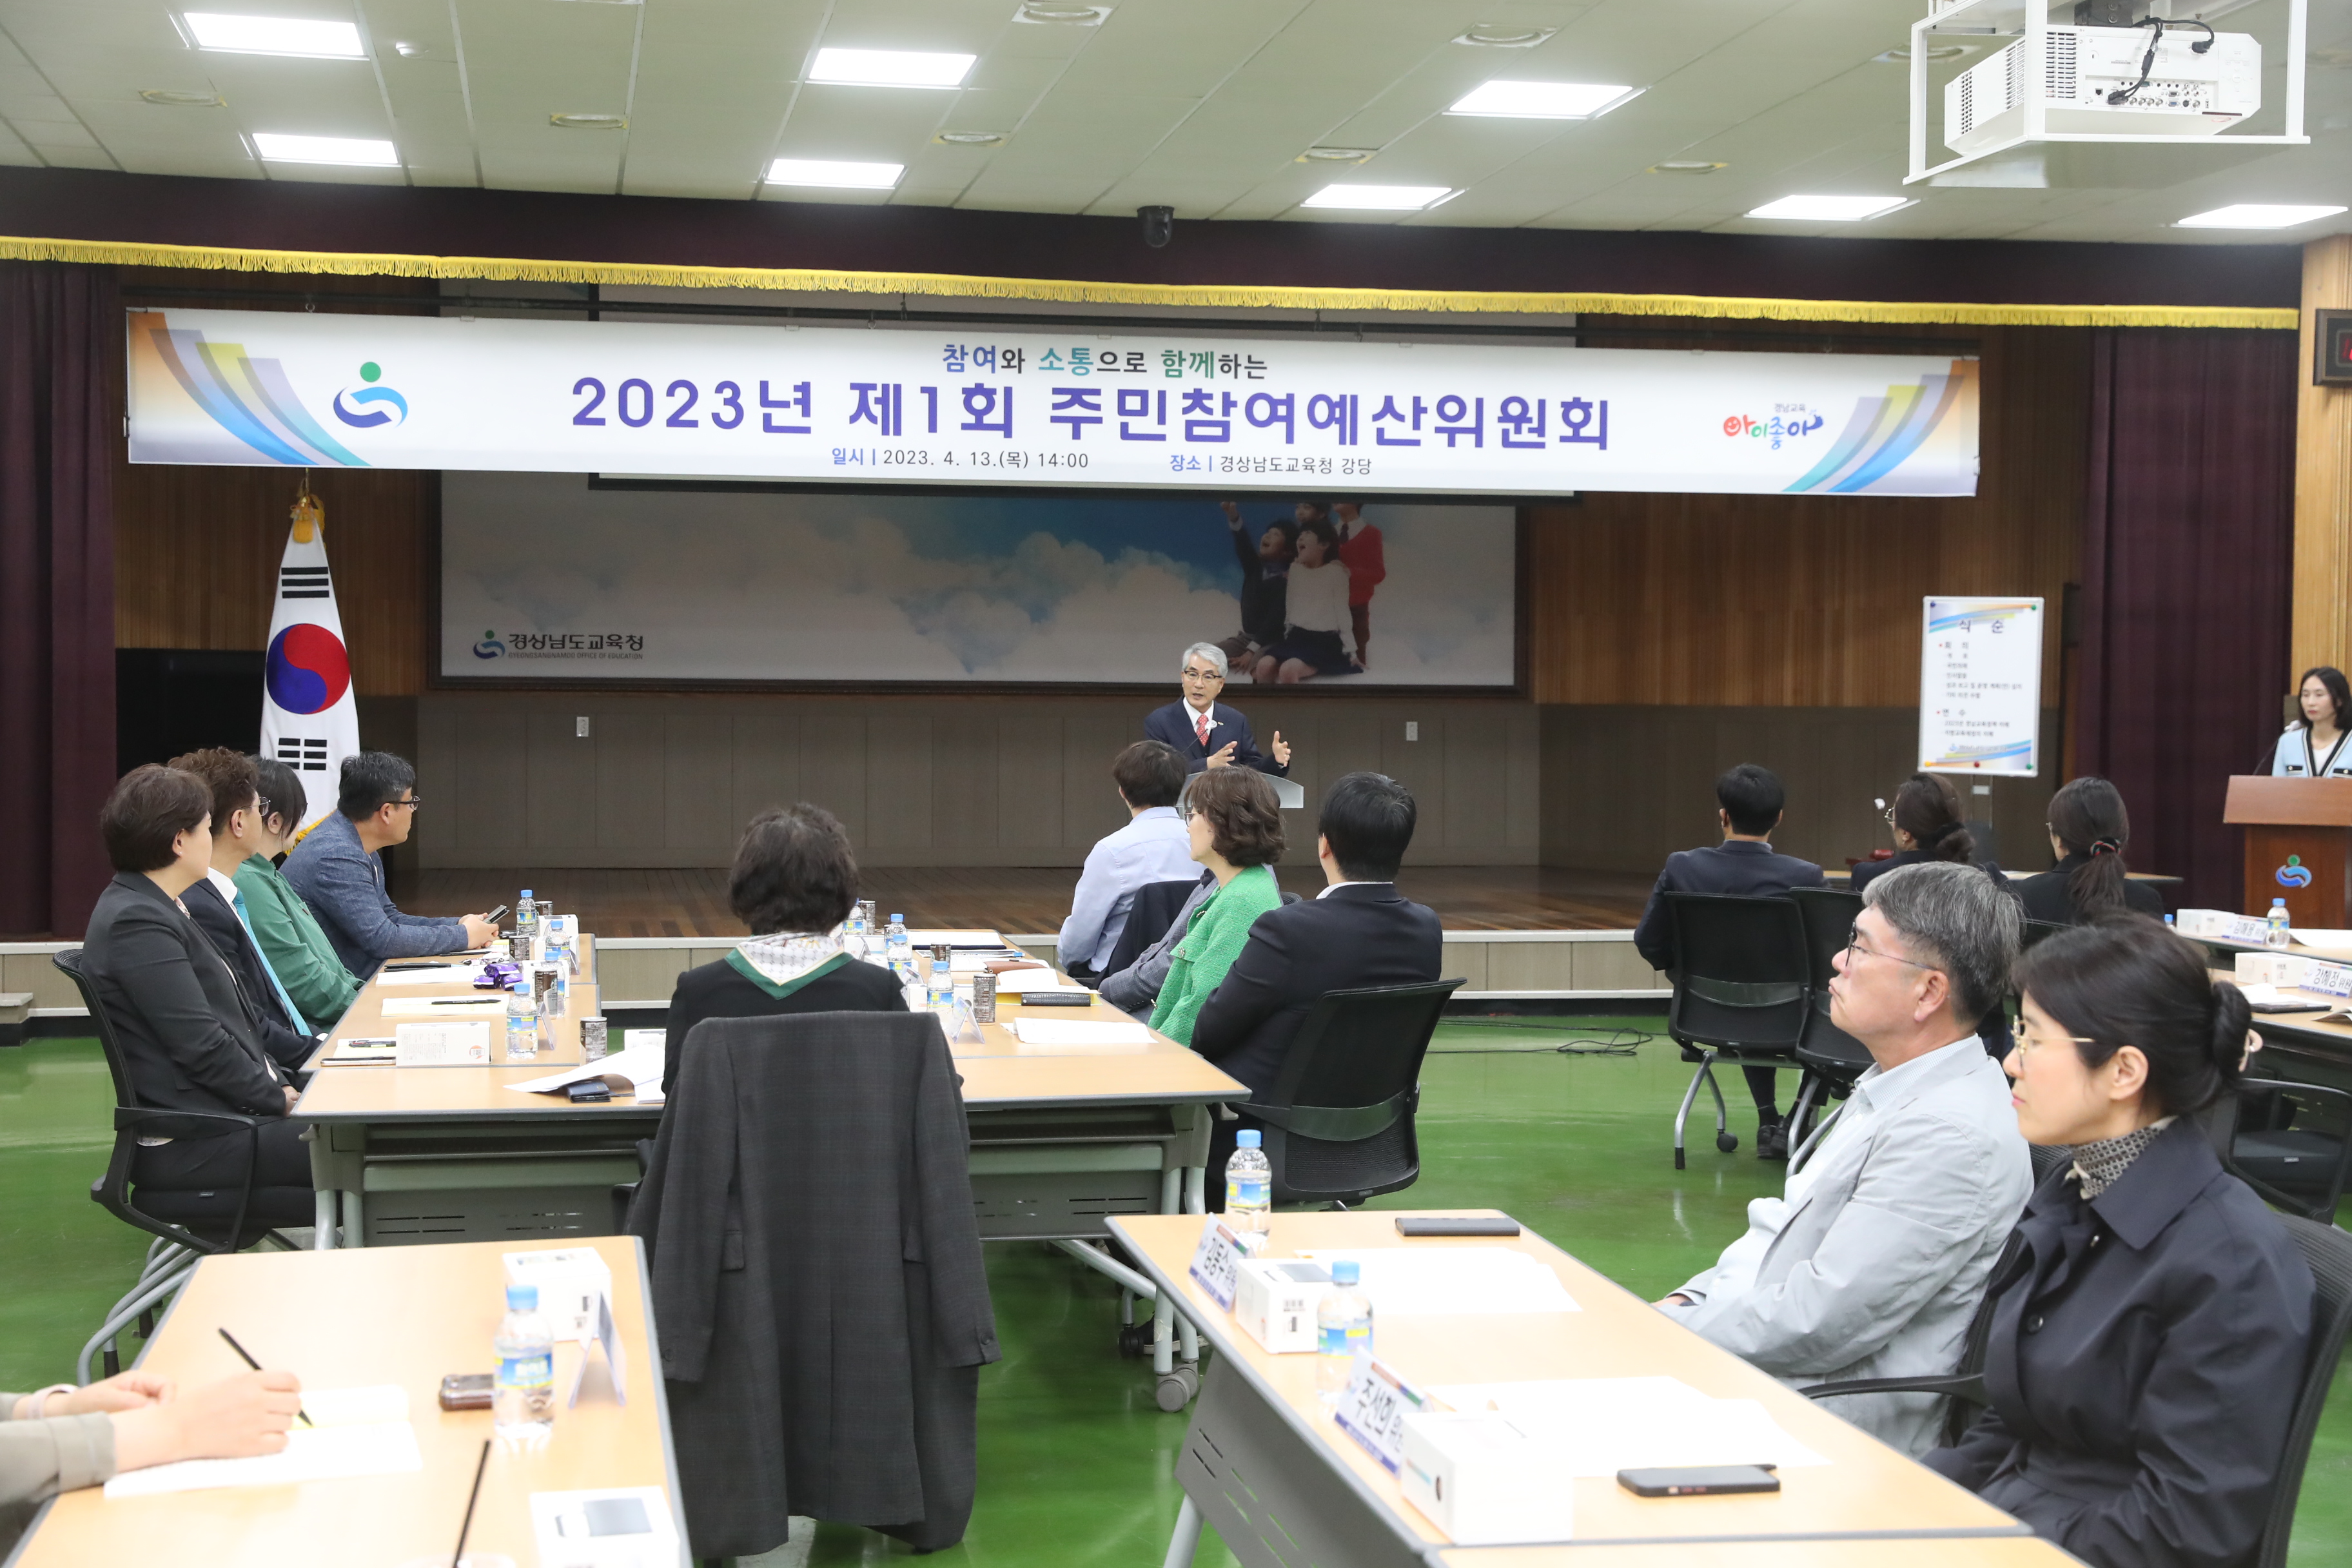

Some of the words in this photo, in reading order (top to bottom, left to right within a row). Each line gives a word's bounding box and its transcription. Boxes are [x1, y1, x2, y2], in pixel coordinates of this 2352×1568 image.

[943, 344, 1026, 377] 참여와
[1038, 347, 1148, 375] 소통으로
[1161, 349, 1268, 380] 함께하는
[572, 377, 812, 435] 2023년
[848, 382, 1013, 439] 제1회
[1050, 387, 1609, 451] 주민참여예산위원회
[832, 447, 863, 466] 일시
[883, 449, 934, 466] 2023.
[943, 451, 960, 466] 4.
[970, 451, 1028, 469] 13.(목)
[1038, 453, 1088, 468] 14:00
[1170, 455, 1202, 472] 장소
[1220, 456, 1332, 475] 경상남도교육청
[1342, 458, 1371, 475] 강당
[509, 633, 643, 652] 경상남도교육청
